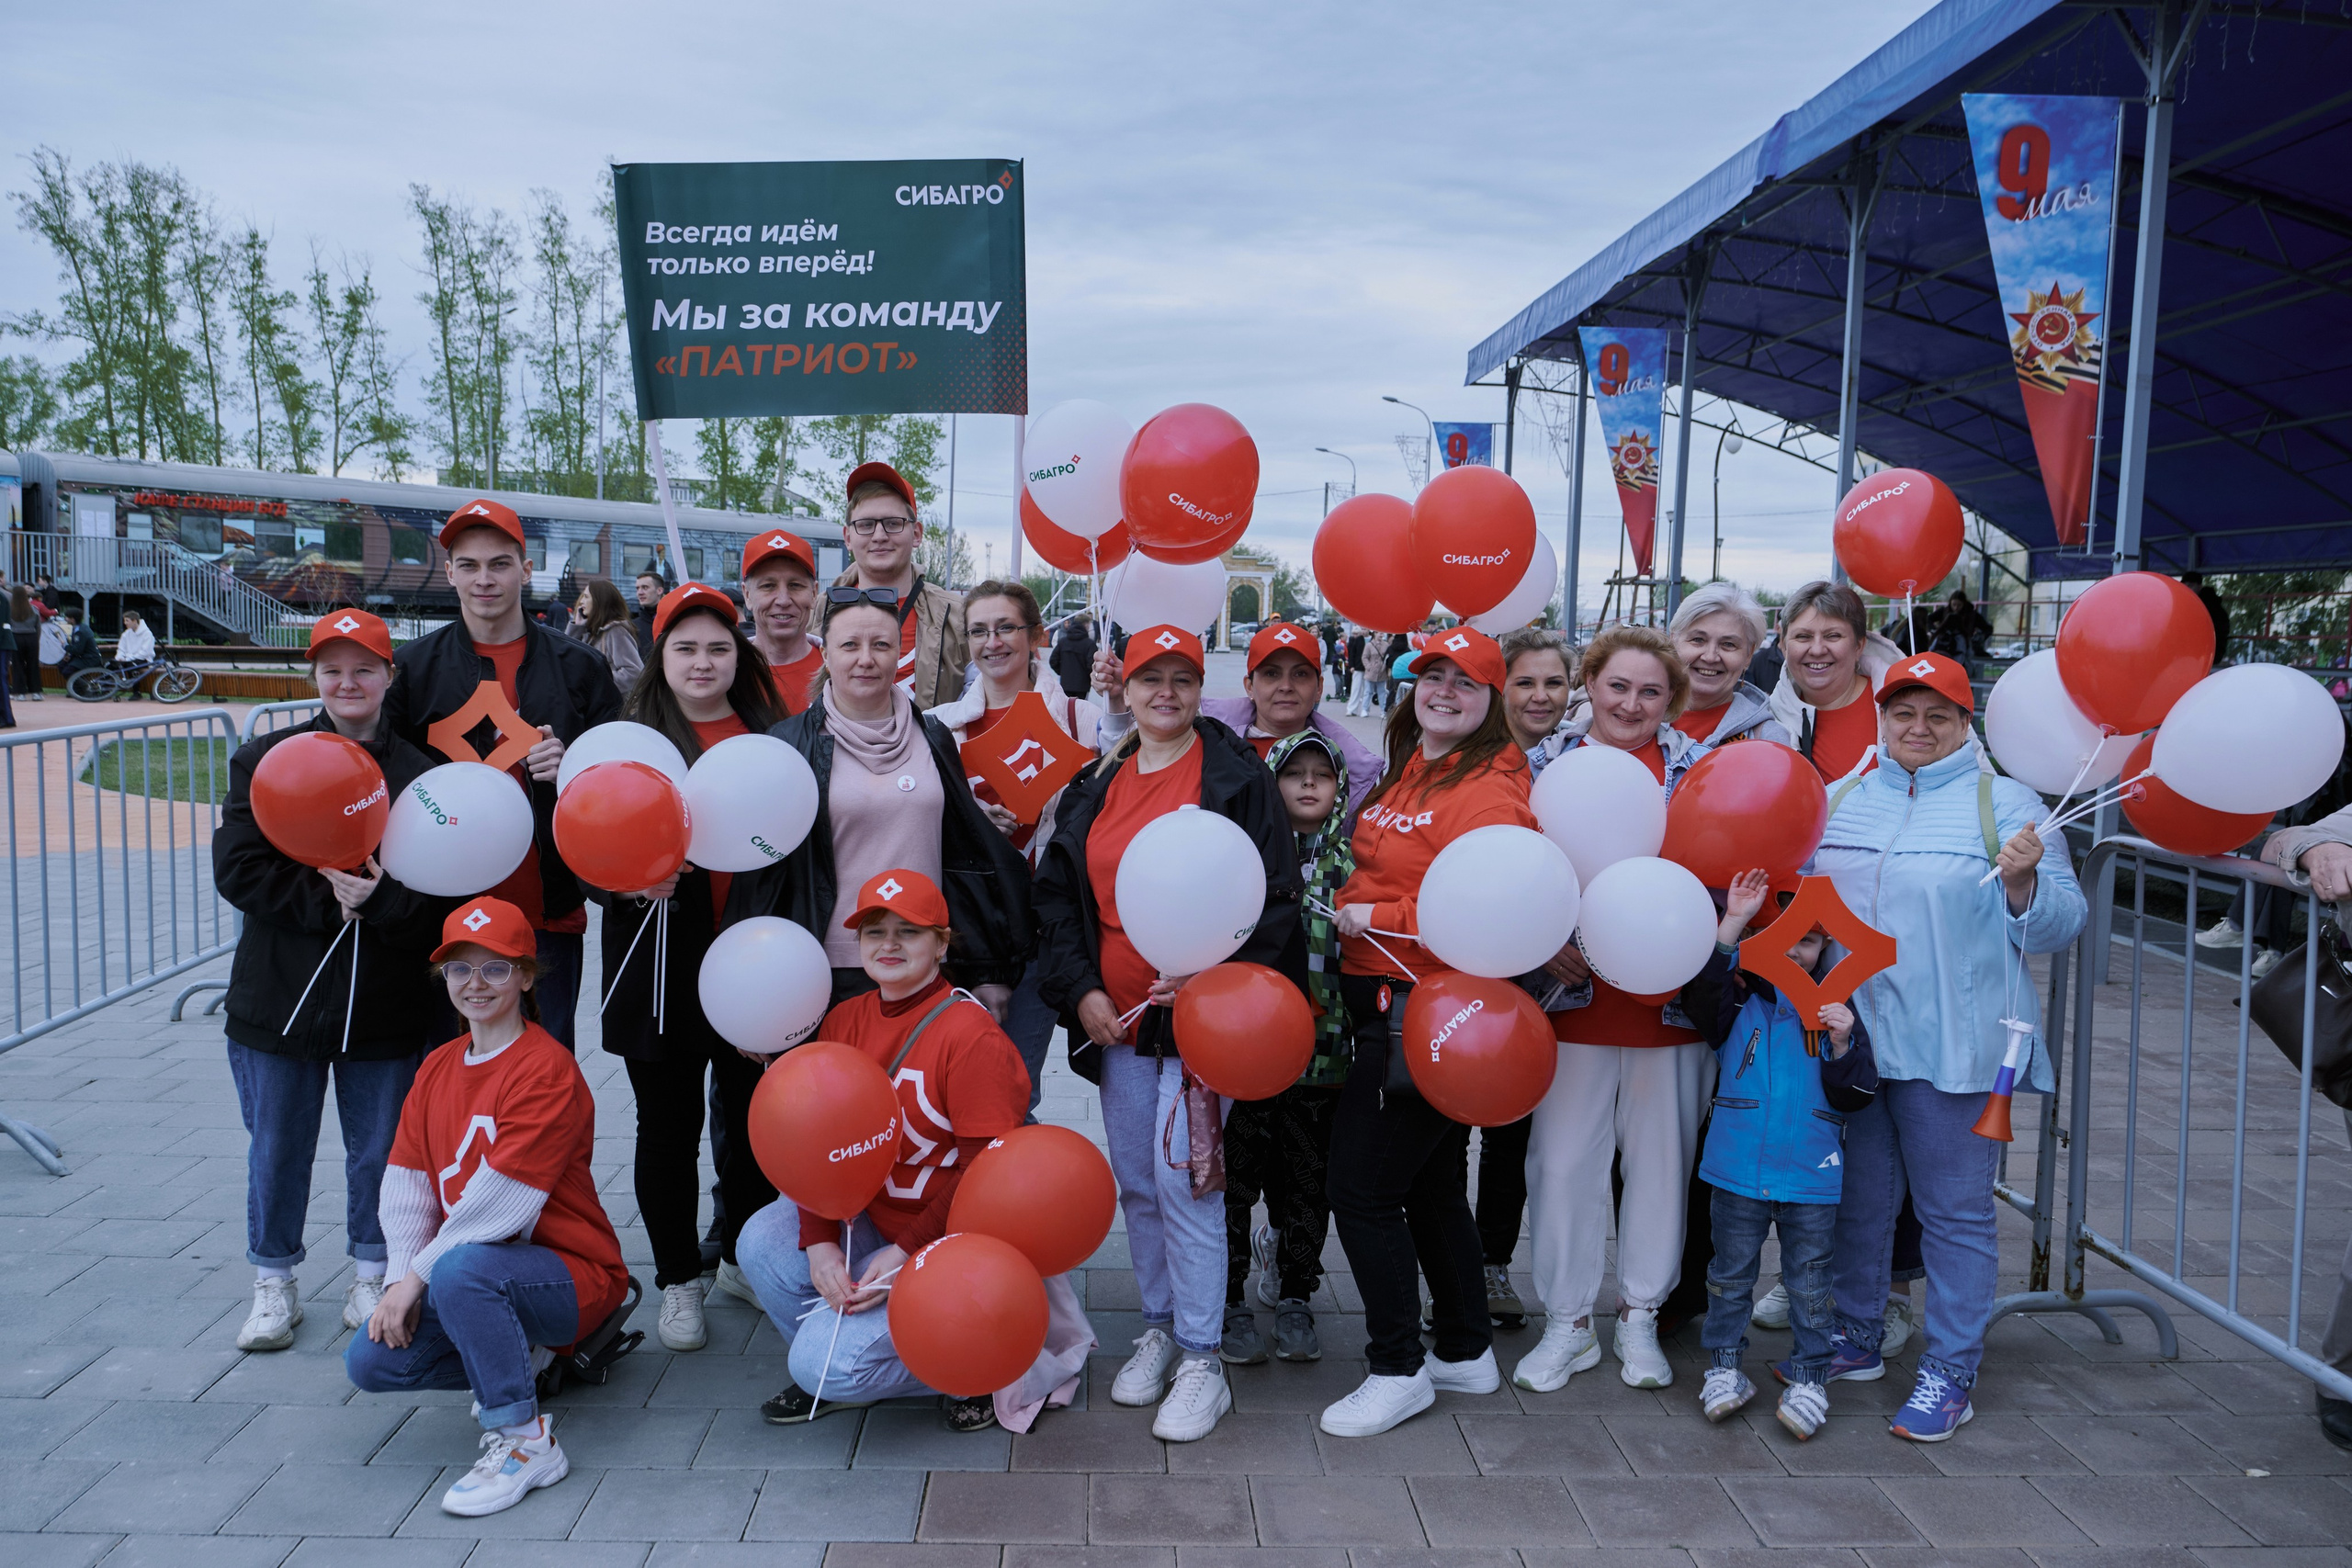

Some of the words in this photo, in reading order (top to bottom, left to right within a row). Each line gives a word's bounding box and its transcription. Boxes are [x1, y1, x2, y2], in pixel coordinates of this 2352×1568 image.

[1996, 124, 2051, 221] 9
[895, 185, 1004, 206] СИБАГРО
[2015, 183, 2100, 224] мая
[645, 221, 752, 246] Всегда
[760, 219, 838, 245] идём
[647, 255, 751, 275] только
[758, 250, 876, 277] вперёд!
[651, 299, 727, 331] Мы
[739, 303, 791, 330] за
[805, 300, 1002, 334] команду
[655, 342, 918, 377] «ПАТРИОТ»
[1600, 344, 1630, 396] 9
[1611, 375, 1657, 398] мая
[1029, 463, 1076, 482] СИБАГРО
[134, 492, 179, 508] КАФЕ
[183, 496, 255, 513] СТАНЦИЯ
[1168, 492, 1225, 525] СИБАГРО
[1846, 487, 1904, 522] СИБАГРО
[1442, 554, 1504, 566] СИБАГРО
[344, 786, 386, 816] СИБАГРО
[412, 782, 447, 825] СИБАГРО
[1576, 926, 1611, 983] СИБАГРО
[1430, 999, 1484, 1052] СИБАГРО
[828, 1128, 893, 1163] СИБАГРО
[1292, 1193, 1325, 1245] JORDA
